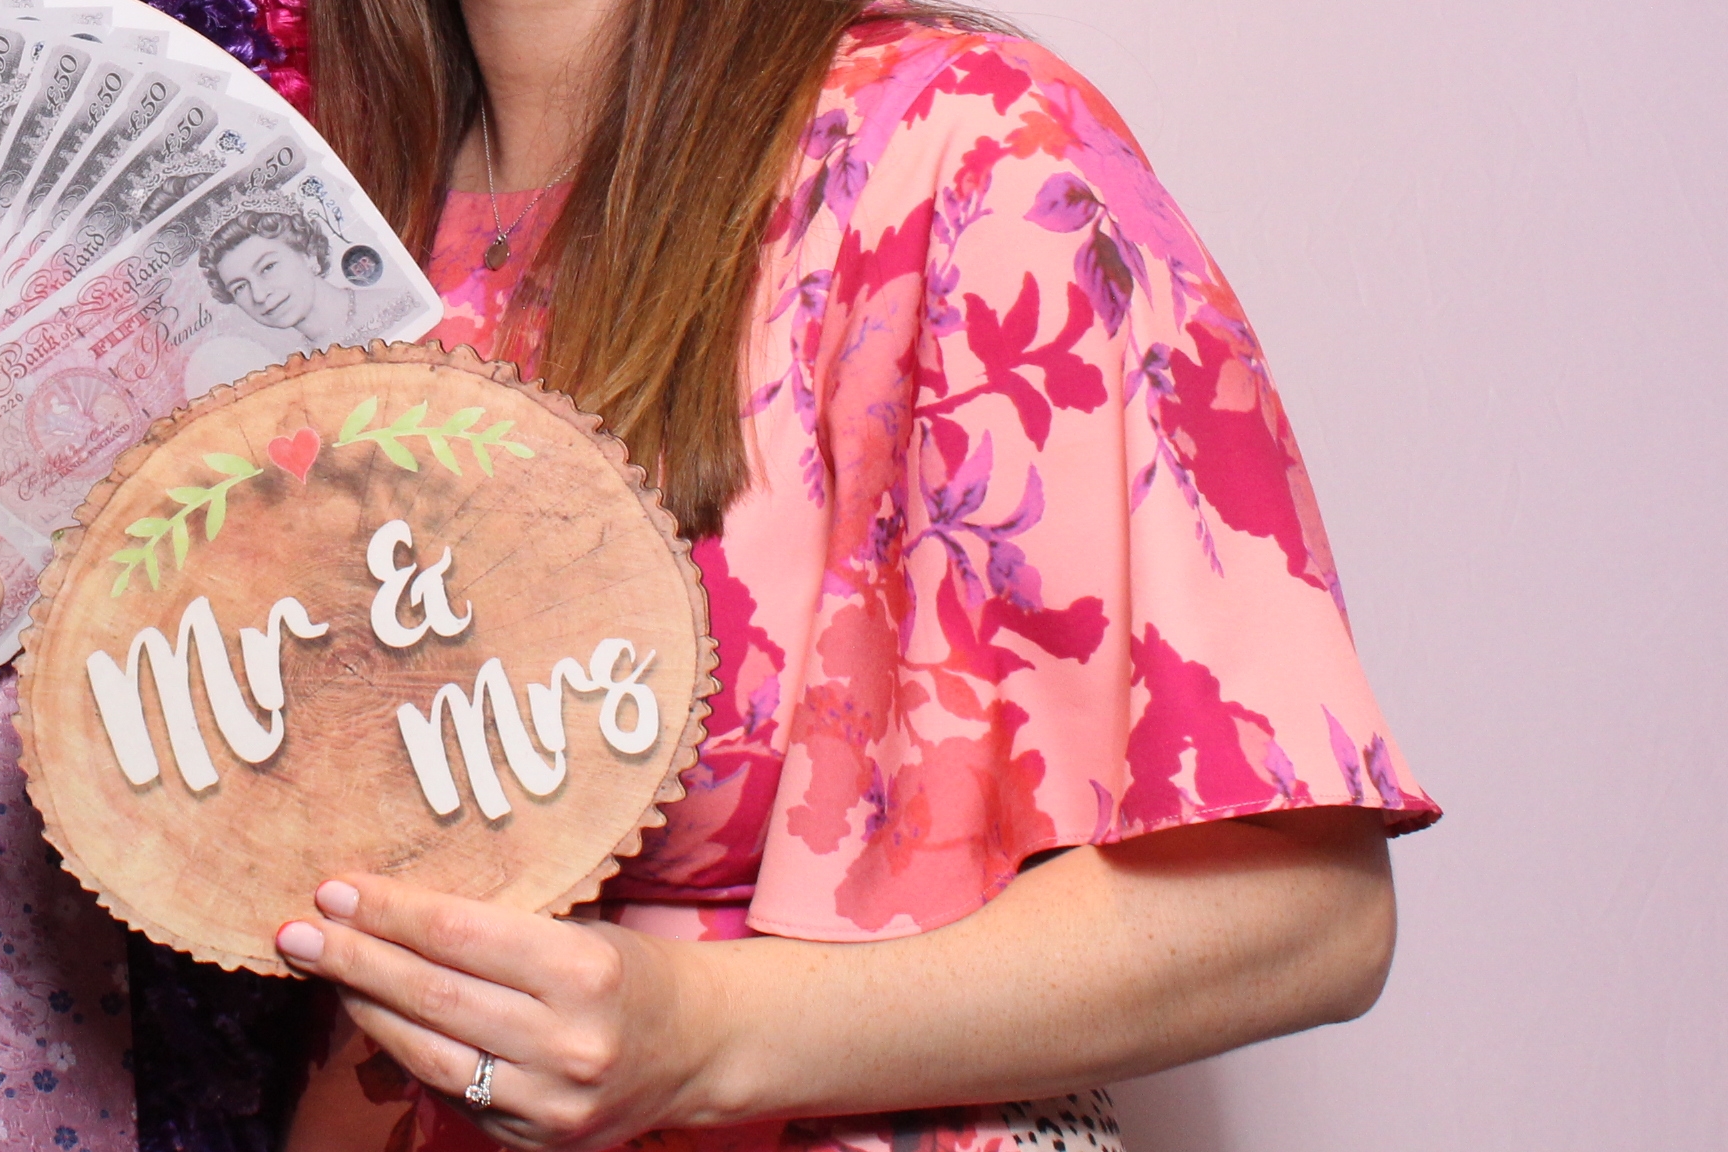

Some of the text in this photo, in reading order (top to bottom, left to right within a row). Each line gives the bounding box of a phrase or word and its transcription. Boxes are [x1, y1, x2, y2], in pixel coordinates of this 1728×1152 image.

[47, 54, 77, 110] £50
[88, 72, 122, 127] £50
[129, 81, 167, 136] £50
[162, 107, 204, 157] £50
[247, 146, 294, 192] £50
[73, 242, 172, 327] England
[88, 295, 167, 359] FIFTY
[117, 303, 212, 382] Pounds
[88, 424, 130, 457] ENGLAND
[86, 519, 472, 792] Mr &
[396, 638, 659, 821] Mrs
